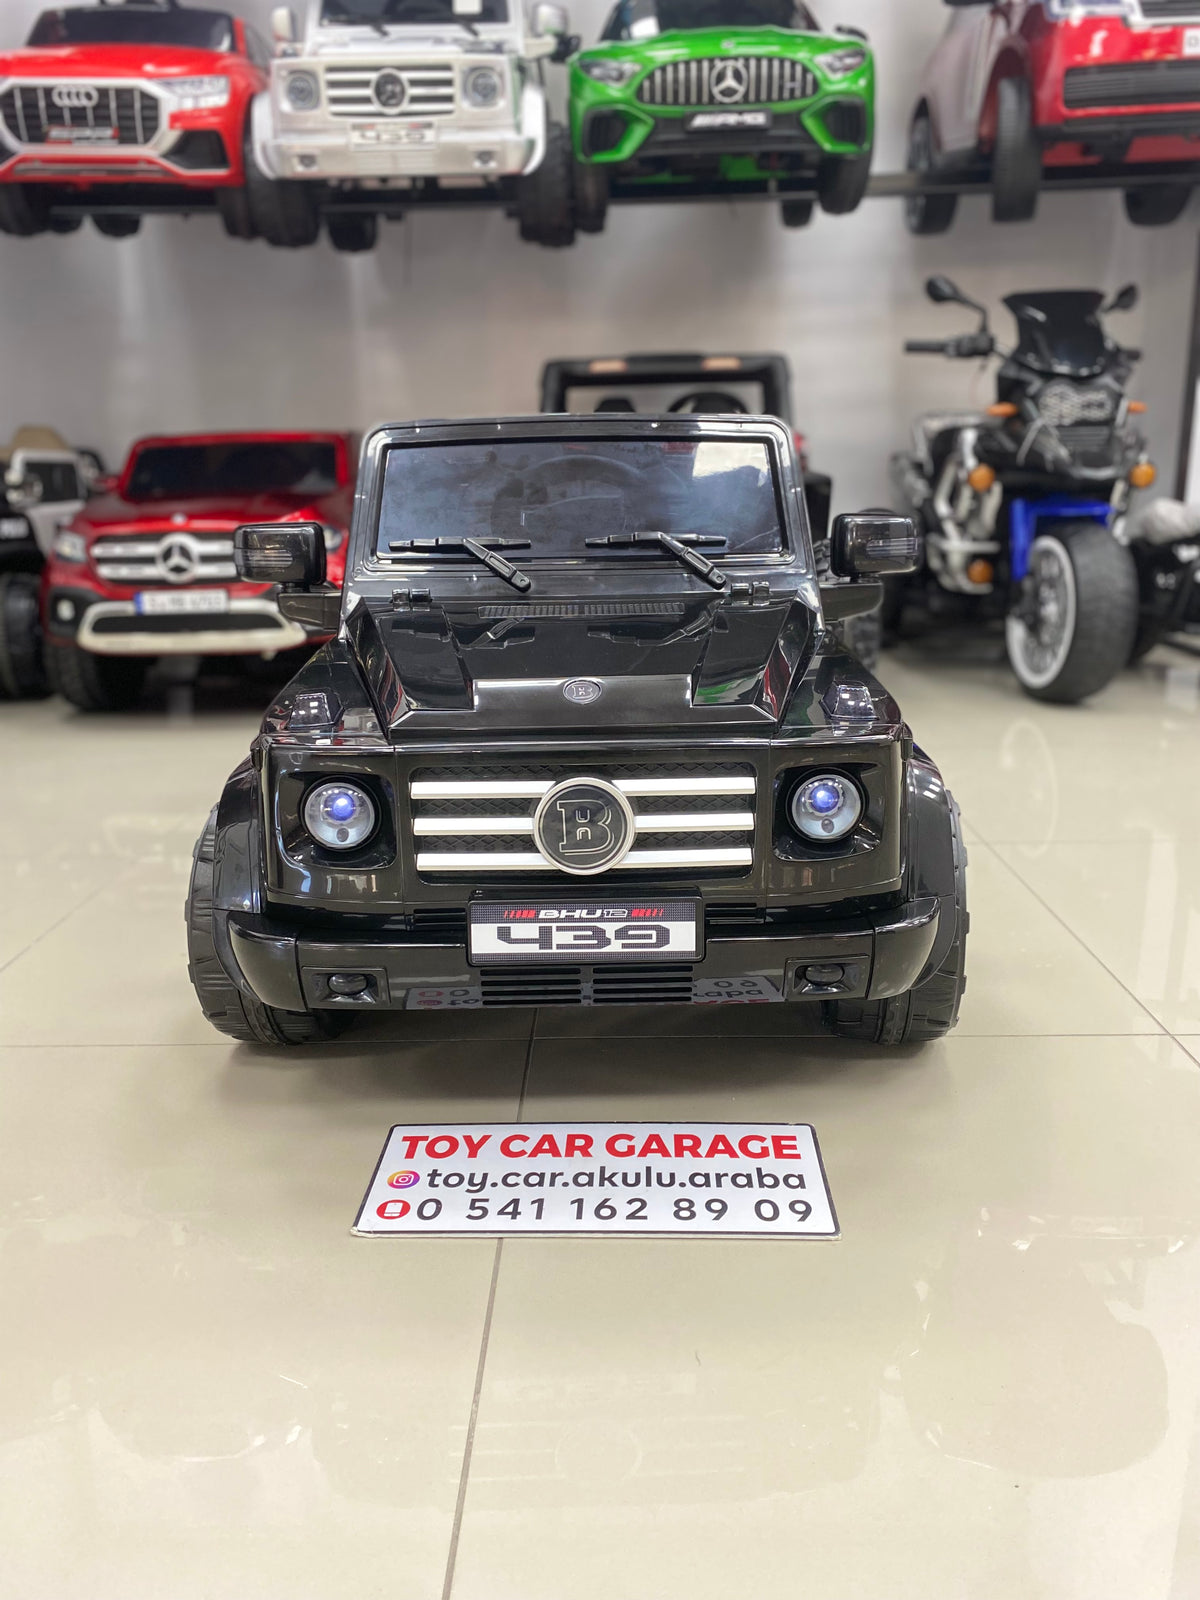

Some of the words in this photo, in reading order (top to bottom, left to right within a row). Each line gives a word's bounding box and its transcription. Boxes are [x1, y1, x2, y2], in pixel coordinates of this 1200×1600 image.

[496, 924, 671, 951] 439
[401, 1134, 493, 1160] TOY
[500, 1133, 594, 1159] CAR
[605, 1133, 802, 1160] GARAGE
[427, 1166, 806, 1194] toy.car.akulu.araba
[416, 1198, 443, 1221] 0
[465, 1197, 545, 1220] 541
[569, 1197, 648, 1220] 162
[673, 1198, 729, 1221] 89
[754, 1199, 812, 1222] 09
